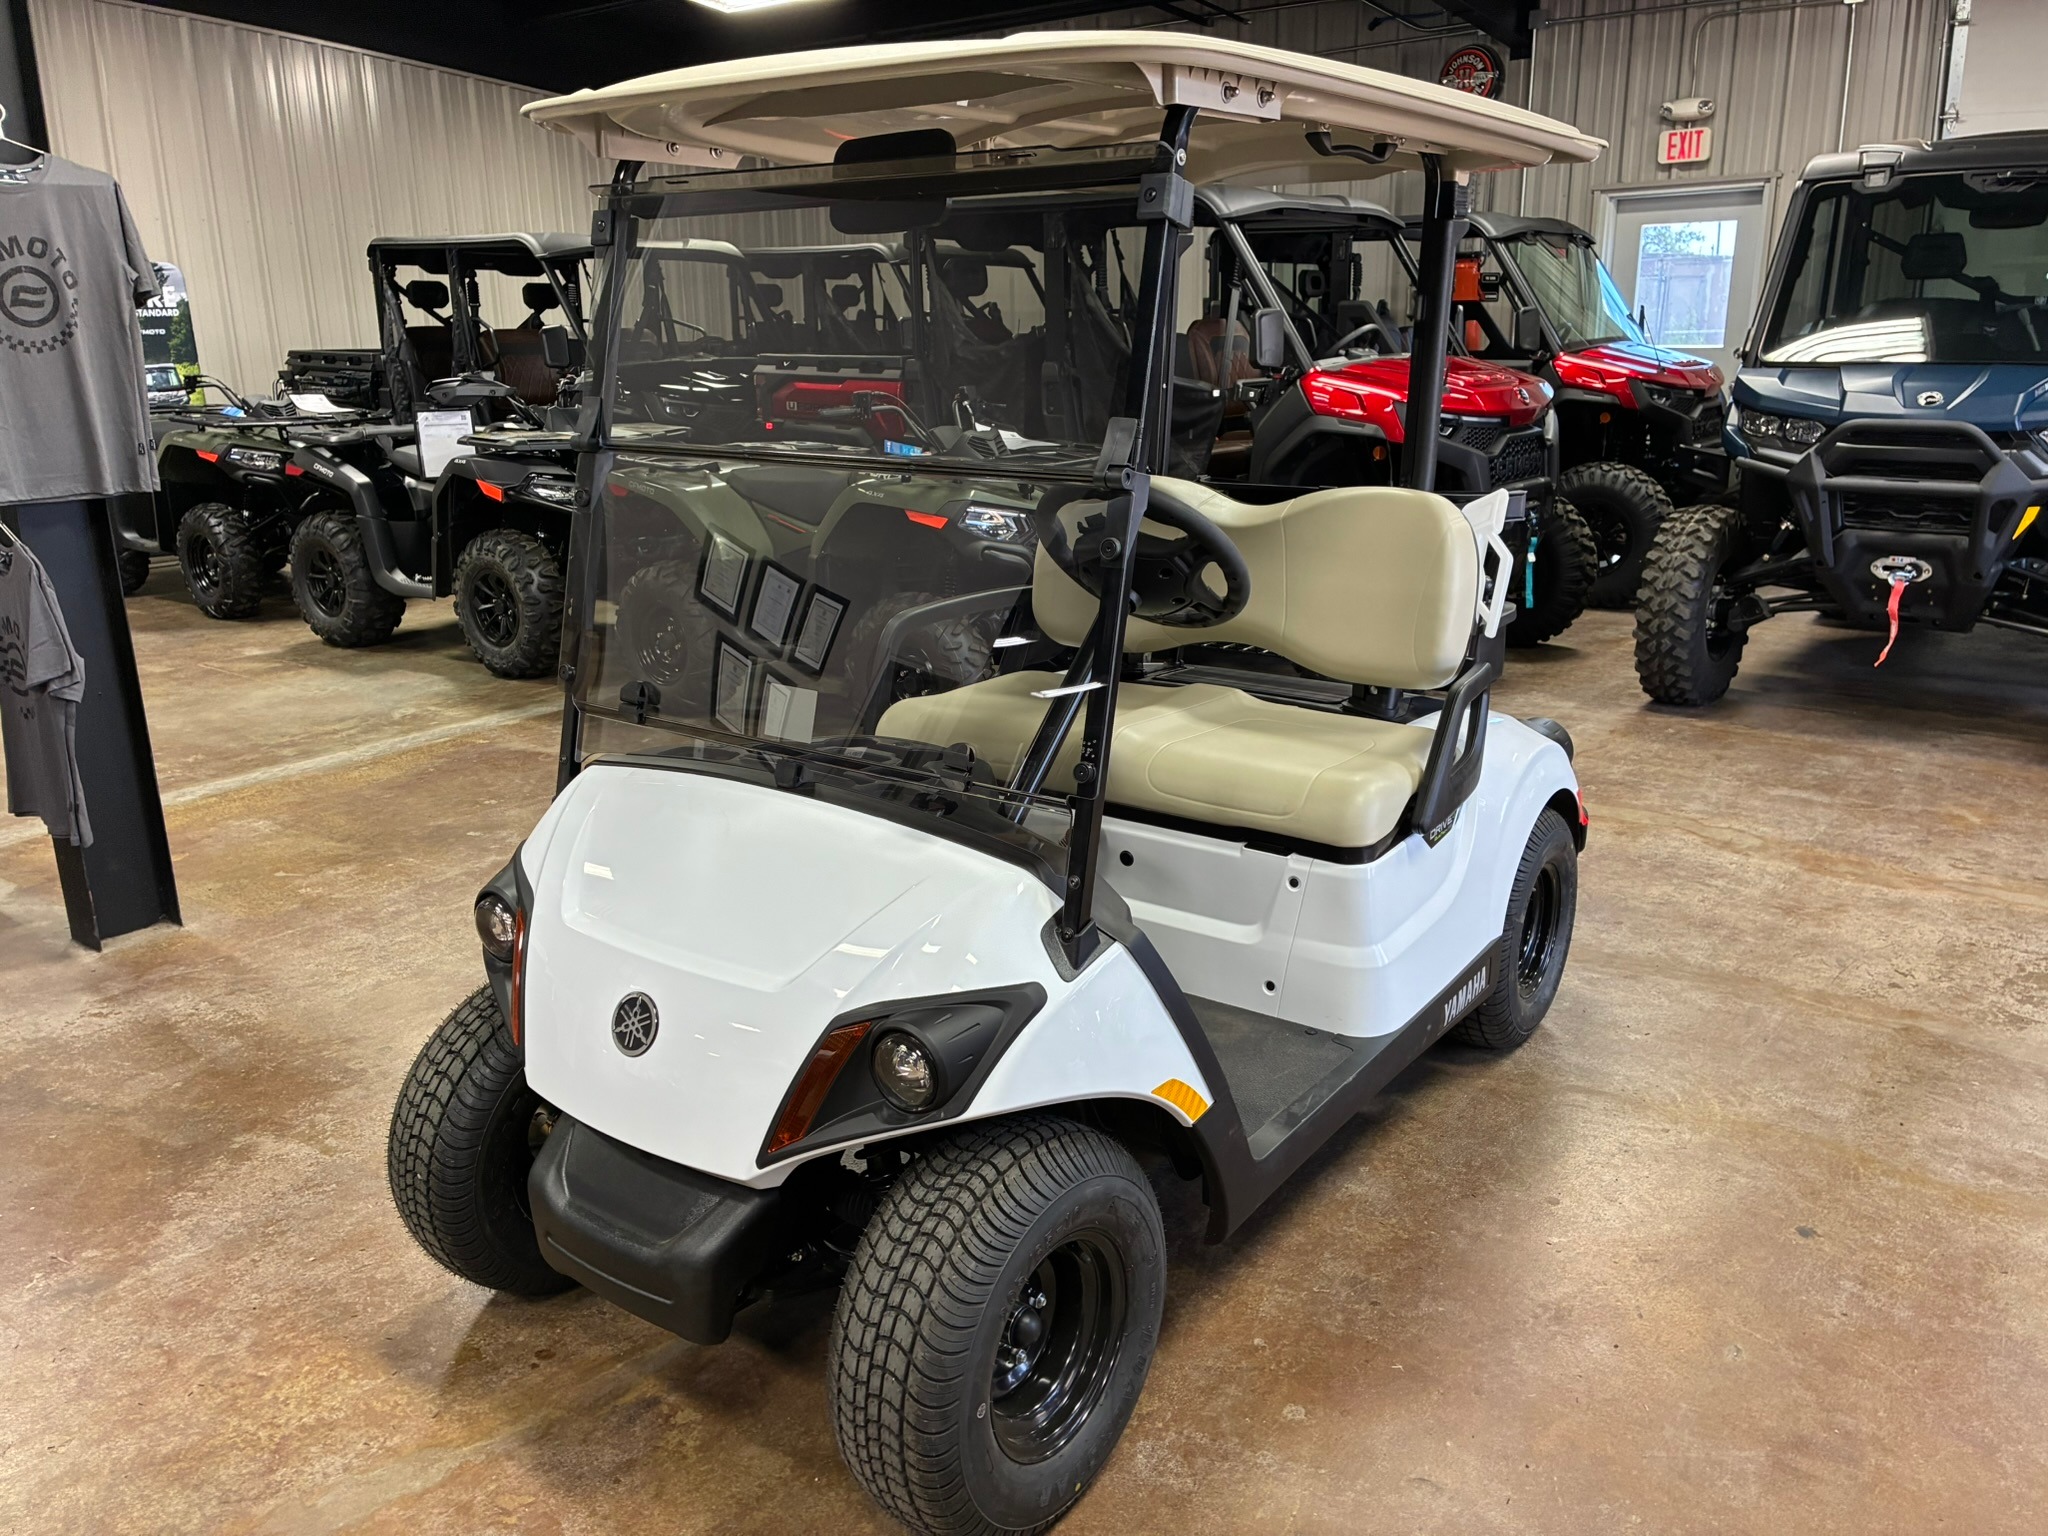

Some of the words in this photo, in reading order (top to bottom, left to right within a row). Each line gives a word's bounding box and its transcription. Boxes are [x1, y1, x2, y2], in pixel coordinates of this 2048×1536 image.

[1449, 54, 1485, 75] JOHNSON
[1667, 130, 1704, 161] EXIT
[313, 462, 334, 478] CFMOTO
[628, 480, 655, 495] CFMOTO
[1443, 965, 1487, 1027] YAMAHA
